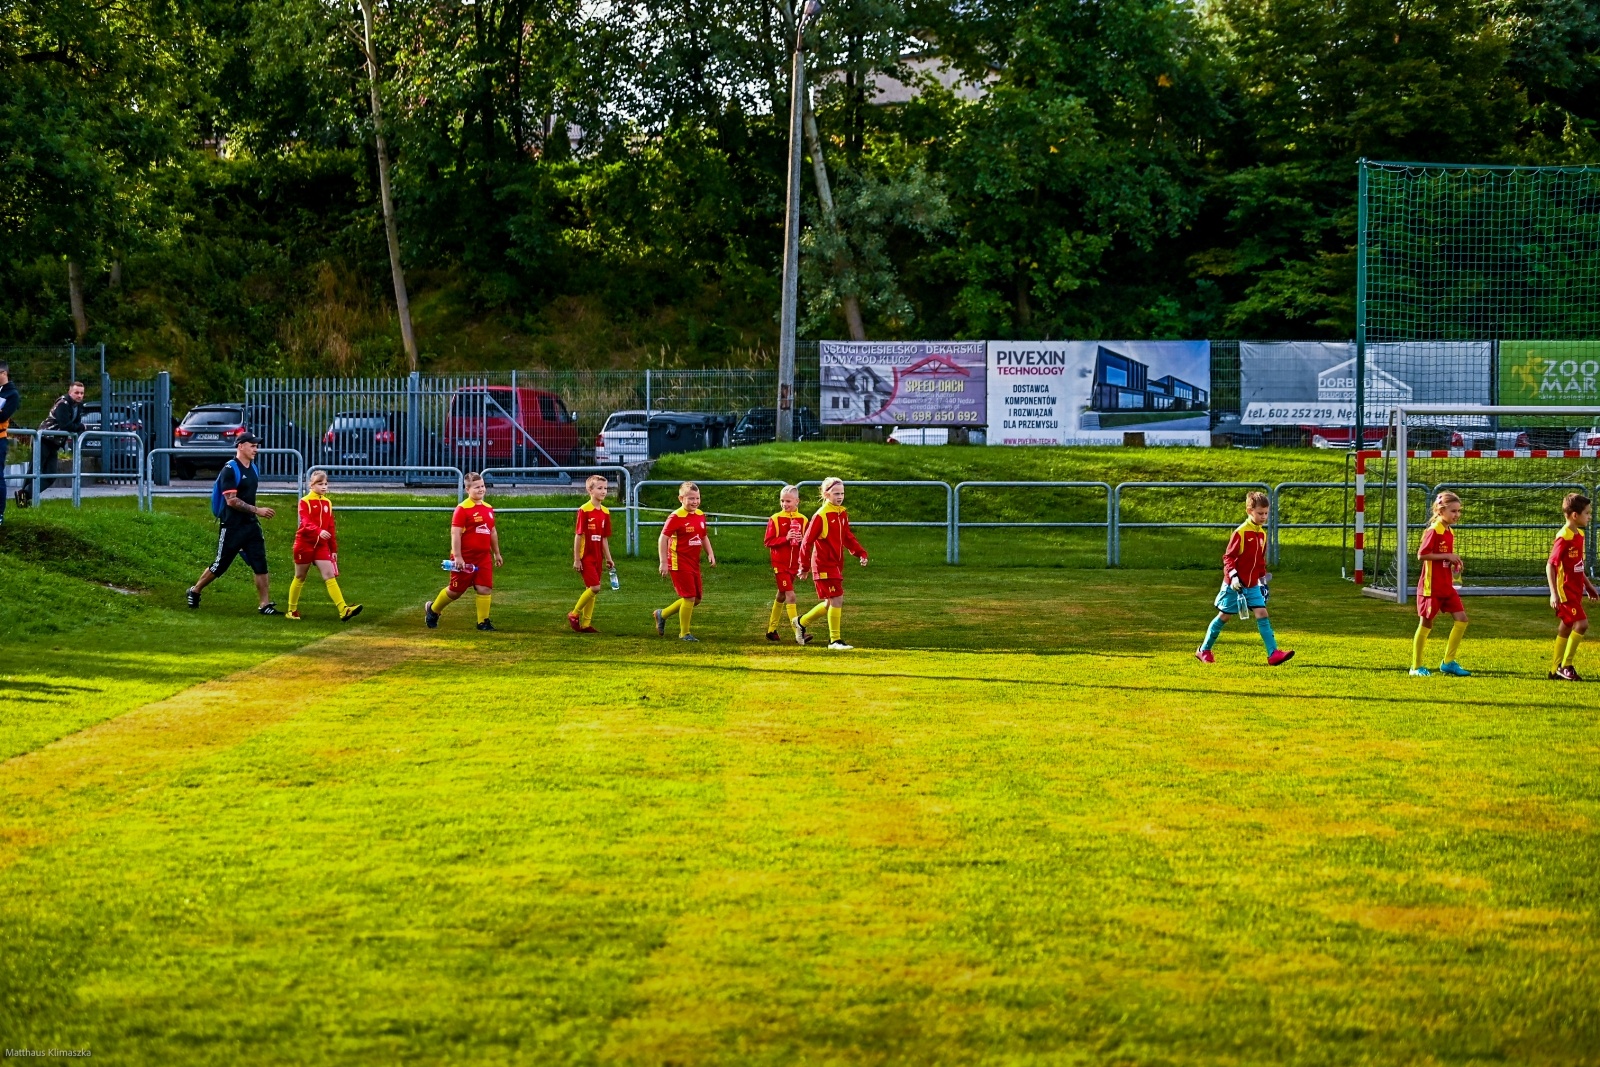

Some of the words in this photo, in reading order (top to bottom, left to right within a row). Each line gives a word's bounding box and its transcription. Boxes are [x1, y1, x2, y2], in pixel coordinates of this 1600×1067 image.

[824, 345, 858, 354] USŁUGI
[861, 345, 918, 354] CIESIELSKO
[926, 344, 983, 354] DEKARSKIE
[824, 355, 853, 364] DOMY
[856, 355, 876, 364] POD
[880, 355, 912, 364] KLUCZ
[996, 351, 1065, 365] PIVEXIN
[997, 366, 1065, 375] TECHNOLOGY
[1543, 360, 1600, 376] ZOO
[906, 380, 964, 392] SPEED-DACH
[1013, 384, 1050, 393] DOSTAWCA
[1539, 377, 1597, 393] MAR
[1004, 396, 1057, 405] KOMPONENTÓW
[894, 412, 909, 420] tel.
[912, 412, 932, 420] 698
[935, 412, 954, 420] 650
[958, 412, 978, 420] 692
[1008, 408, 1012, 416] I
[1014, 407, 1053, 418] ROZWIĄZAŃ
[1248, 408, 1265, 418] tel.
[1268, 408, 1288, 418] 602
[1292, 408, 1310, 418] 252
[1314, 408, 1334, 419] 219,
[1004, 420, 1017, 428] DLA
[1018, 420, 1058, 428] PRZEMYSŁU
